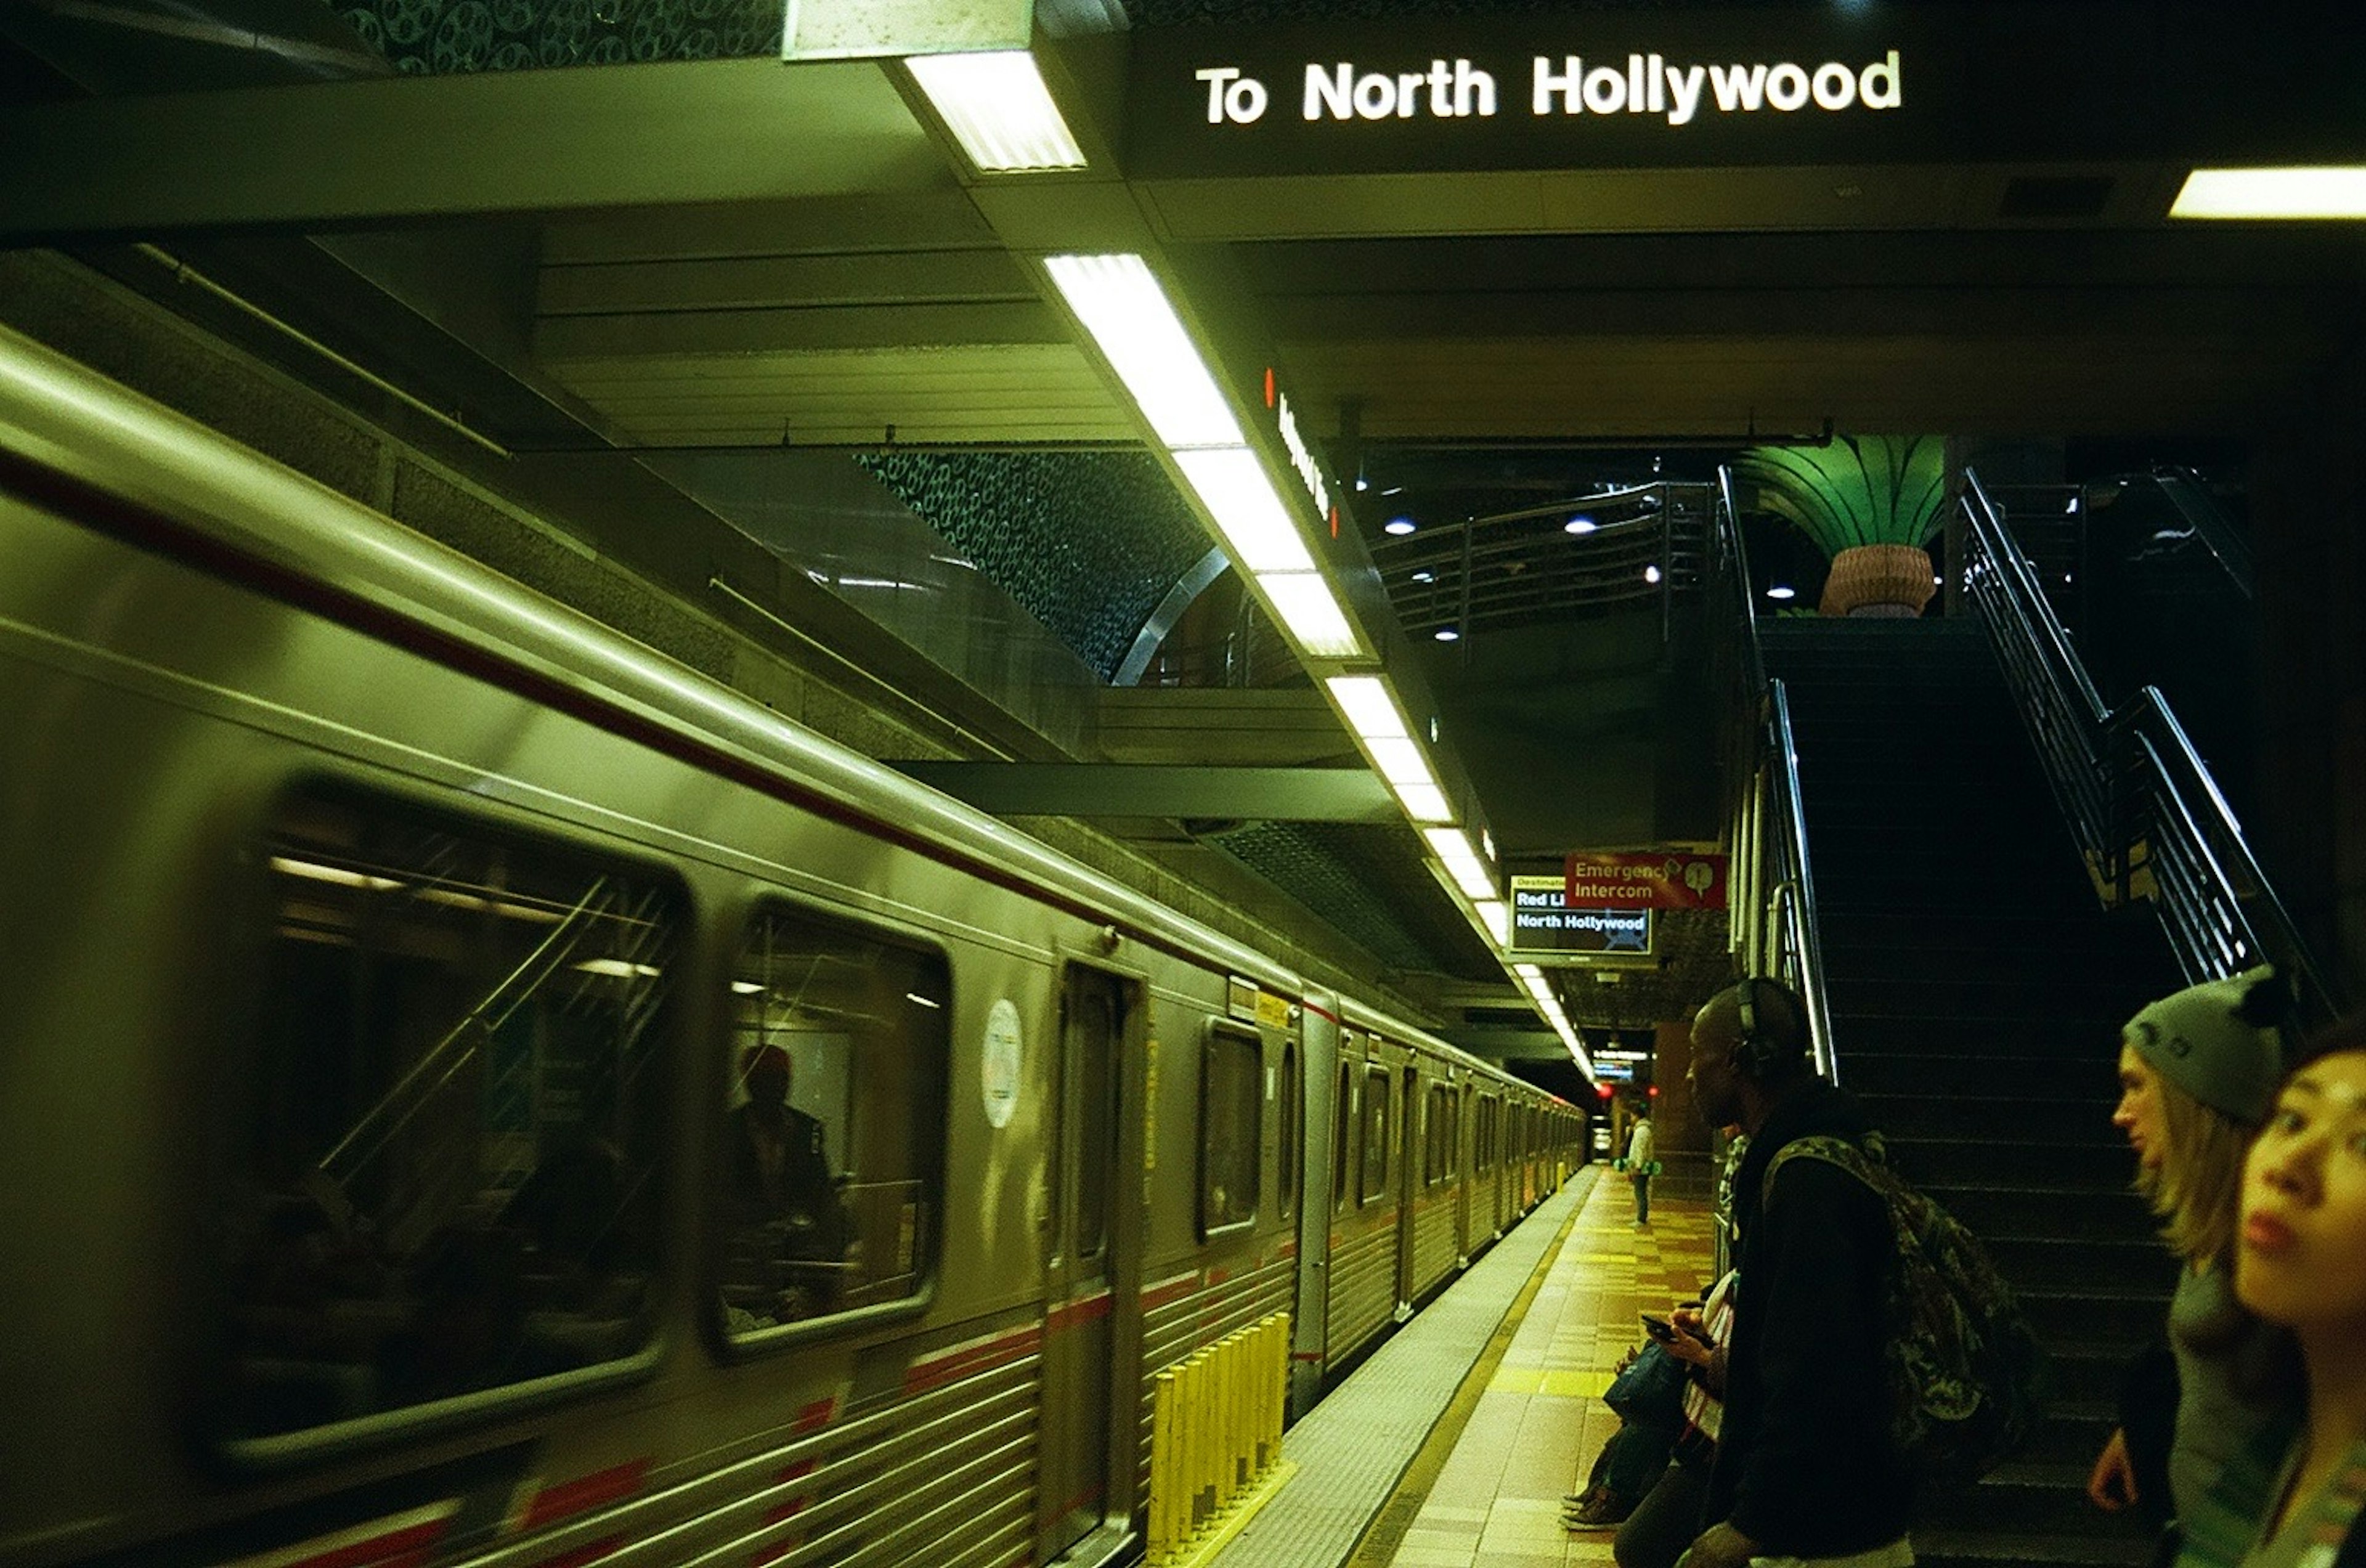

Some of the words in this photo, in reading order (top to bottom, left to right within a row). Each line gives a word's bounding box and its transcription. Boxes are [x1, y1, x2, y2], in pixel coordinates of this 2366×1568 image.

[1195, 67, 1268, 124] To
[1303, 58, 1497, 121] North
[1532, 50, 1902, 126] Hollywood
[1575, 863, 1669, 882] Emergency
[1517, 892, 1547, 906] Red
[1575, 883, 1652, 898] Intercom
[1517, 914, 1561, 927] North
[1565, 916, 1645, 932] Hollywood
